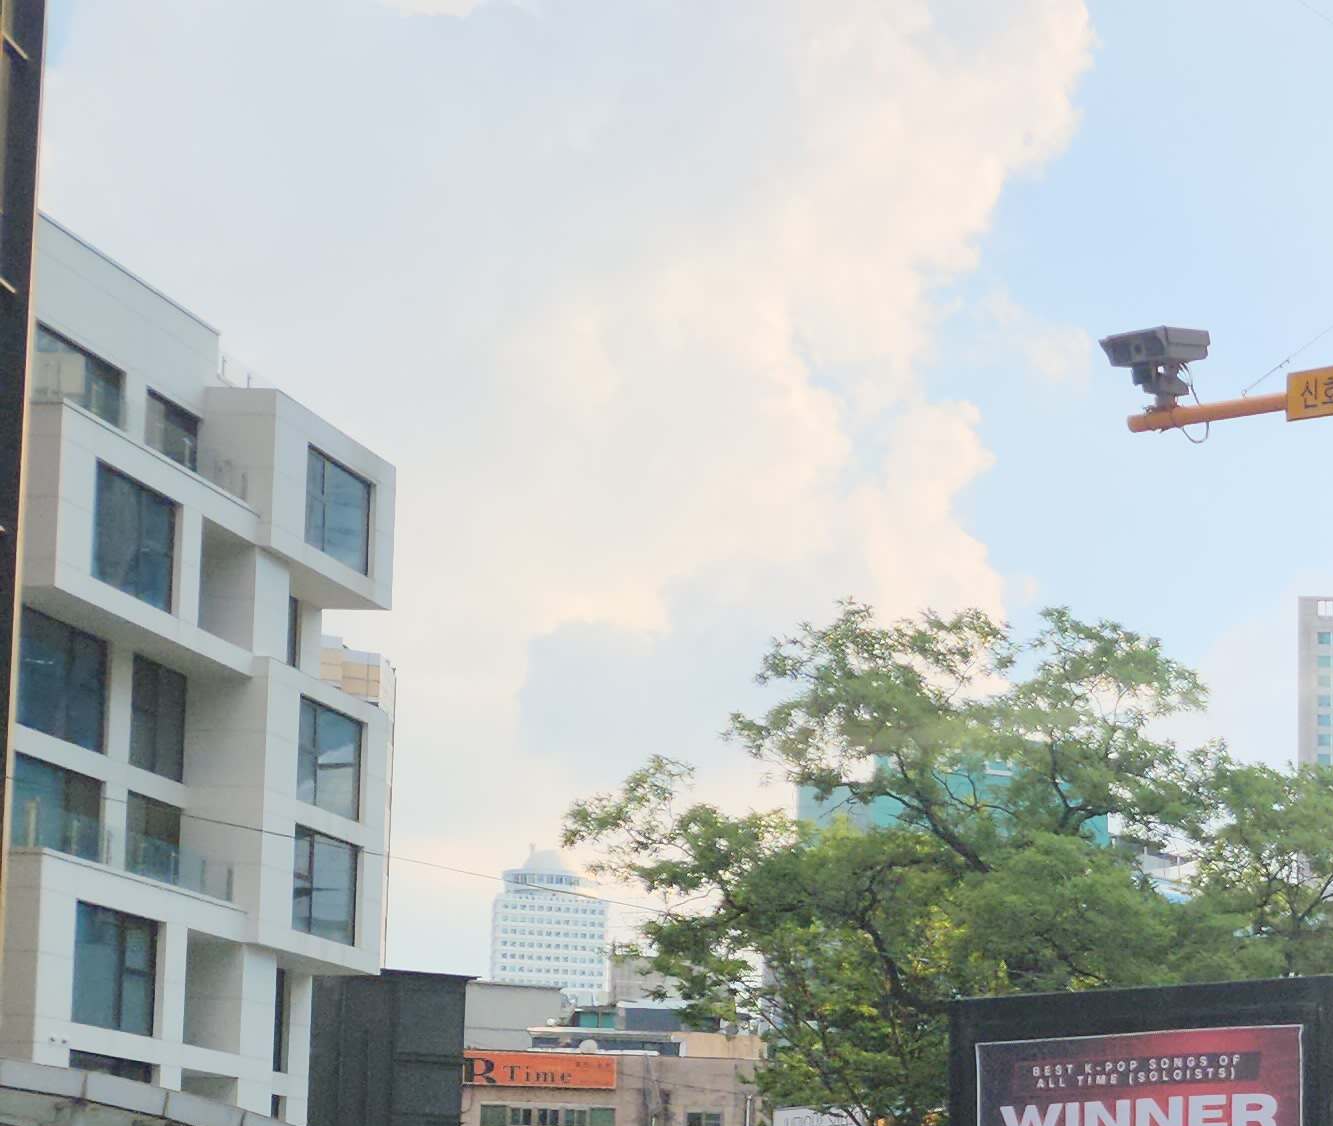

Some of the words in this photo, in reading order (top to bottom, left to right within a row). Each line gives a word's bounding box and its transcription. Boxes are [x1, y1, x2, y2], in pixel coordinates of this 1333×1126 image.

[503, 1065, 573, 1083] Time
[1032, 1064, 1074, 1077] BEST
[1084, 1060, 1139, 1074] K-POP
[1148, 1056, 1209, 1070] SONGS
[1219, 1054, 1241, 1066] OF
[1036, 1078, 1066, 1088] ALL
[1076, 1073, 1119, 1087] TIME
[1128, 1067, 1236, 1086] (SOLOISTS)
